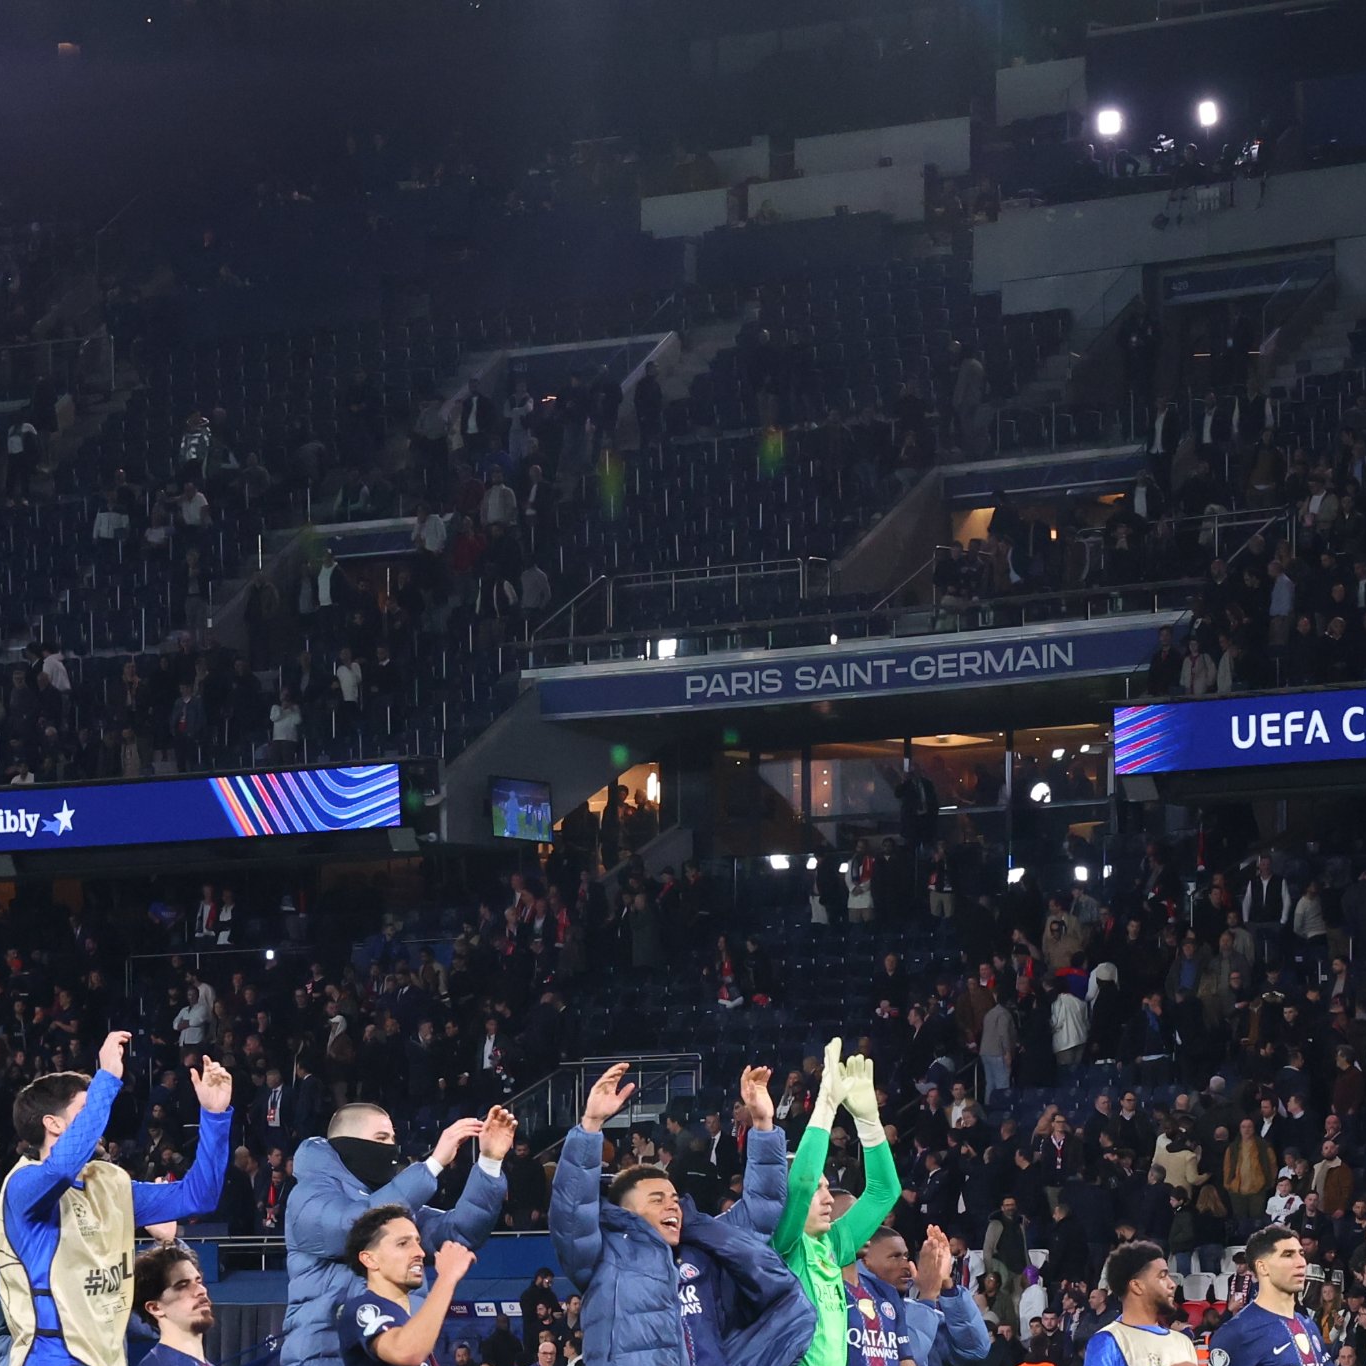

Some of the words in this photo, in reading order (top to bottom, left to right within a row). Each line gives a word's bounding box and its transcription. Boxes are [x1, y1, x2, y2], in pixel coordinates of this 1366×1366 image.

[686, 669, 782, 699] PARIS
[795, 642, 1073, 692] SAINT-GERMAIN
[1231, 709, 1331, 749] UEFA
[846, 1327, 898, 1348] QATAR
[861, 1346, 899, 1360] AIRWAYS
